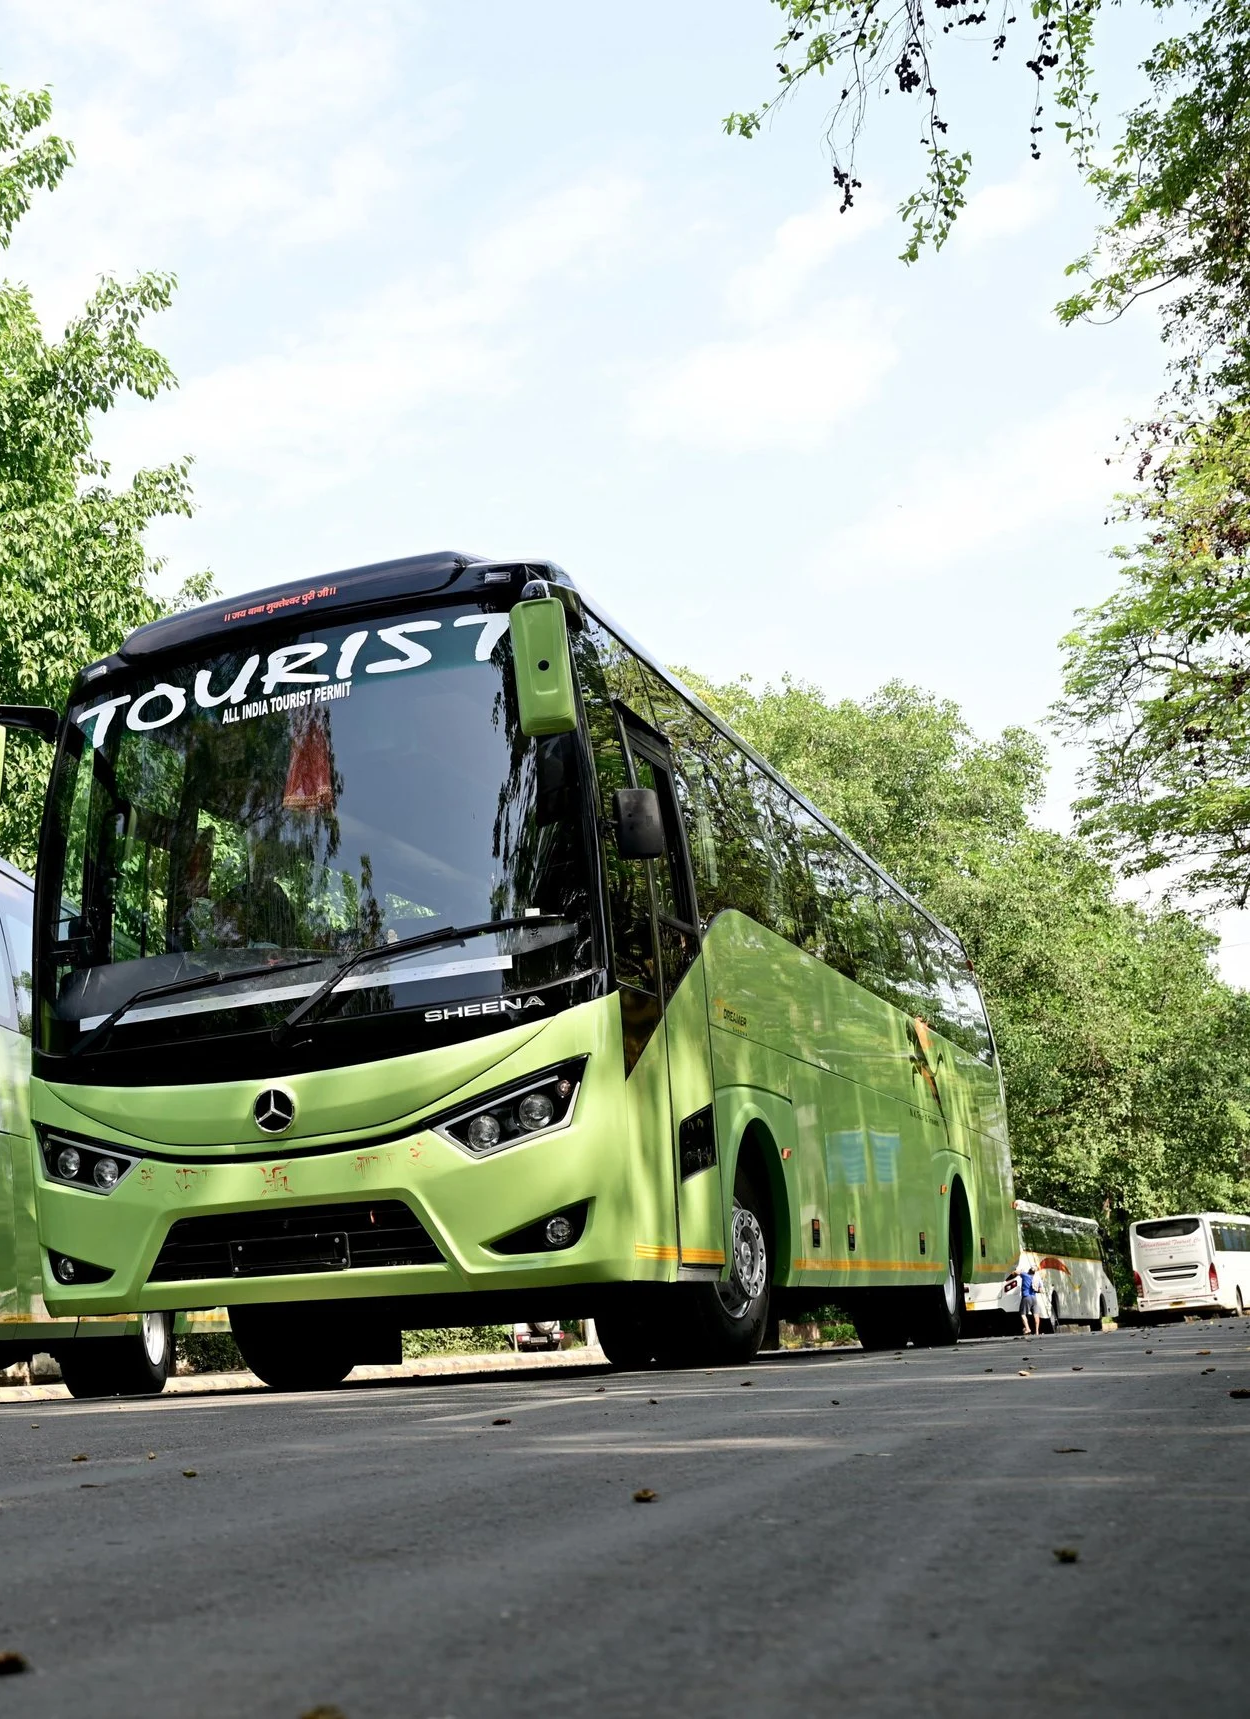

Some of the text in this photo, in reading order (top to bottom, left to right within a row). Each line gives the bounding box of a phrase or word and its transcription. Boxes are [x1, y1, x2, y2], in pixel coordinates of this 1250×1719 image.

[77, 612, 510, 748] TOURIST
[222, 681, 352, 724] ALL INDIA TOURIST PERMIT
[424, 995, 546, 1022] SHEENA
[723, 1008, 747, 1027] DREAMER
